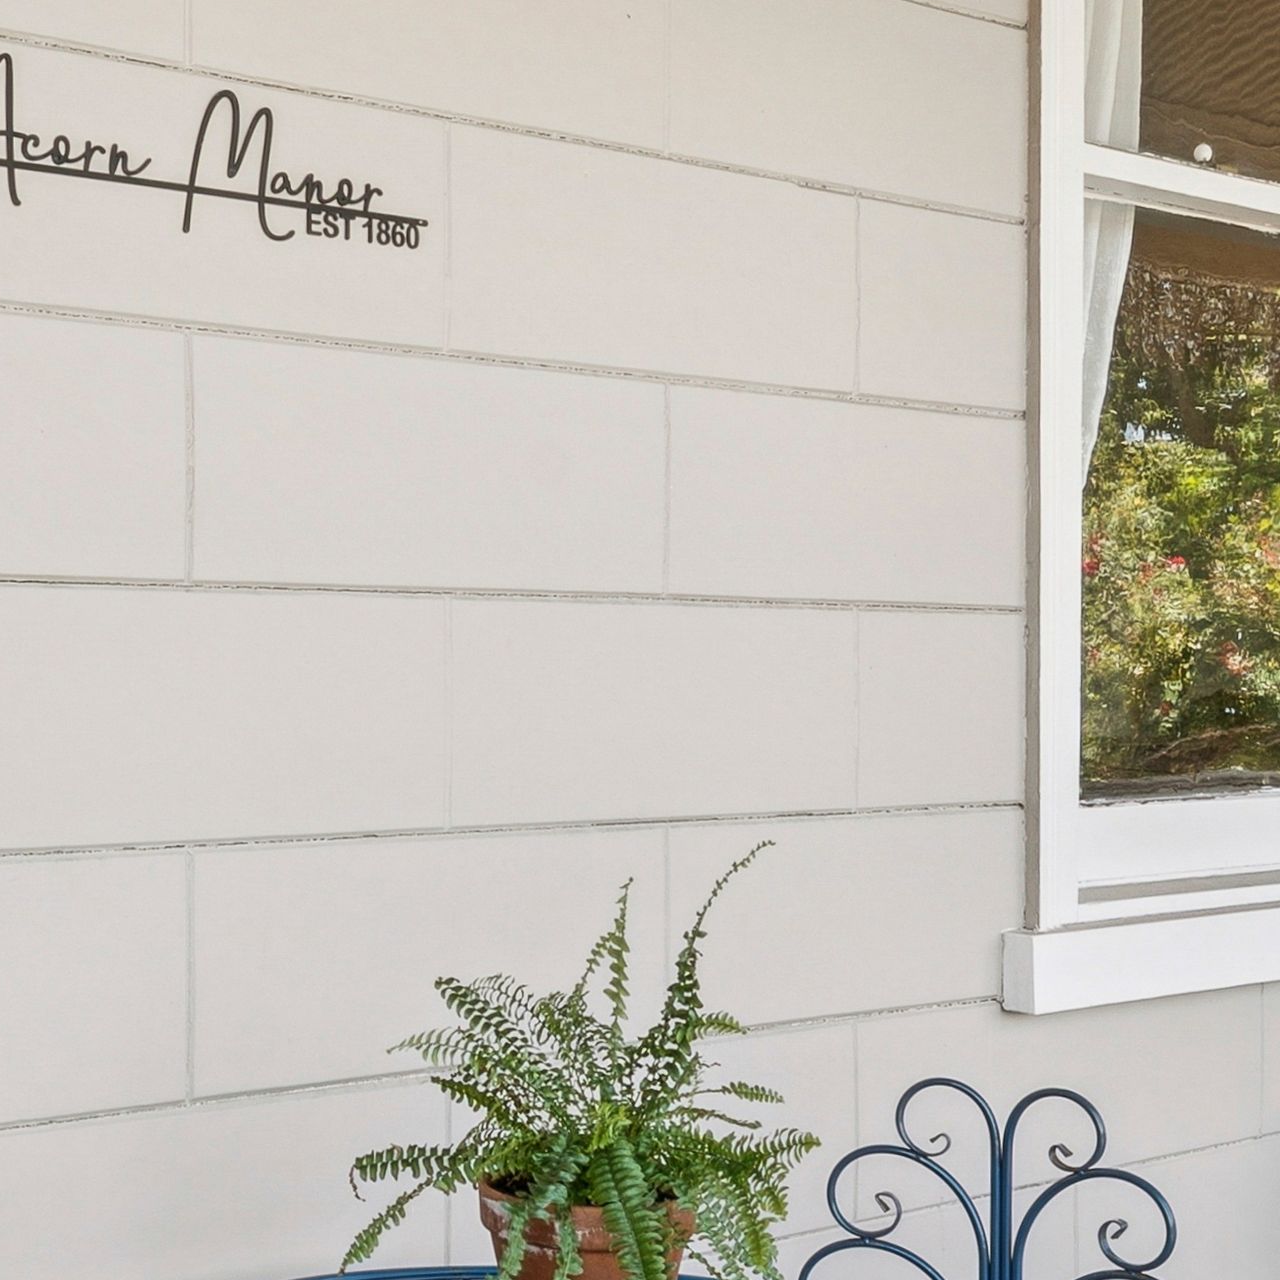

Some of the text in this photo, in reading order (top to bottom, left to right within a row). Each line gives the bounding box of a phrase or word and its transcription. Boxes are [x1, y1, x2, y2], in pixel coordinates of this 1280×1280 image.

[183, 89, 383, 241] Manor
[306, 210, 420, 250] EST 1860
